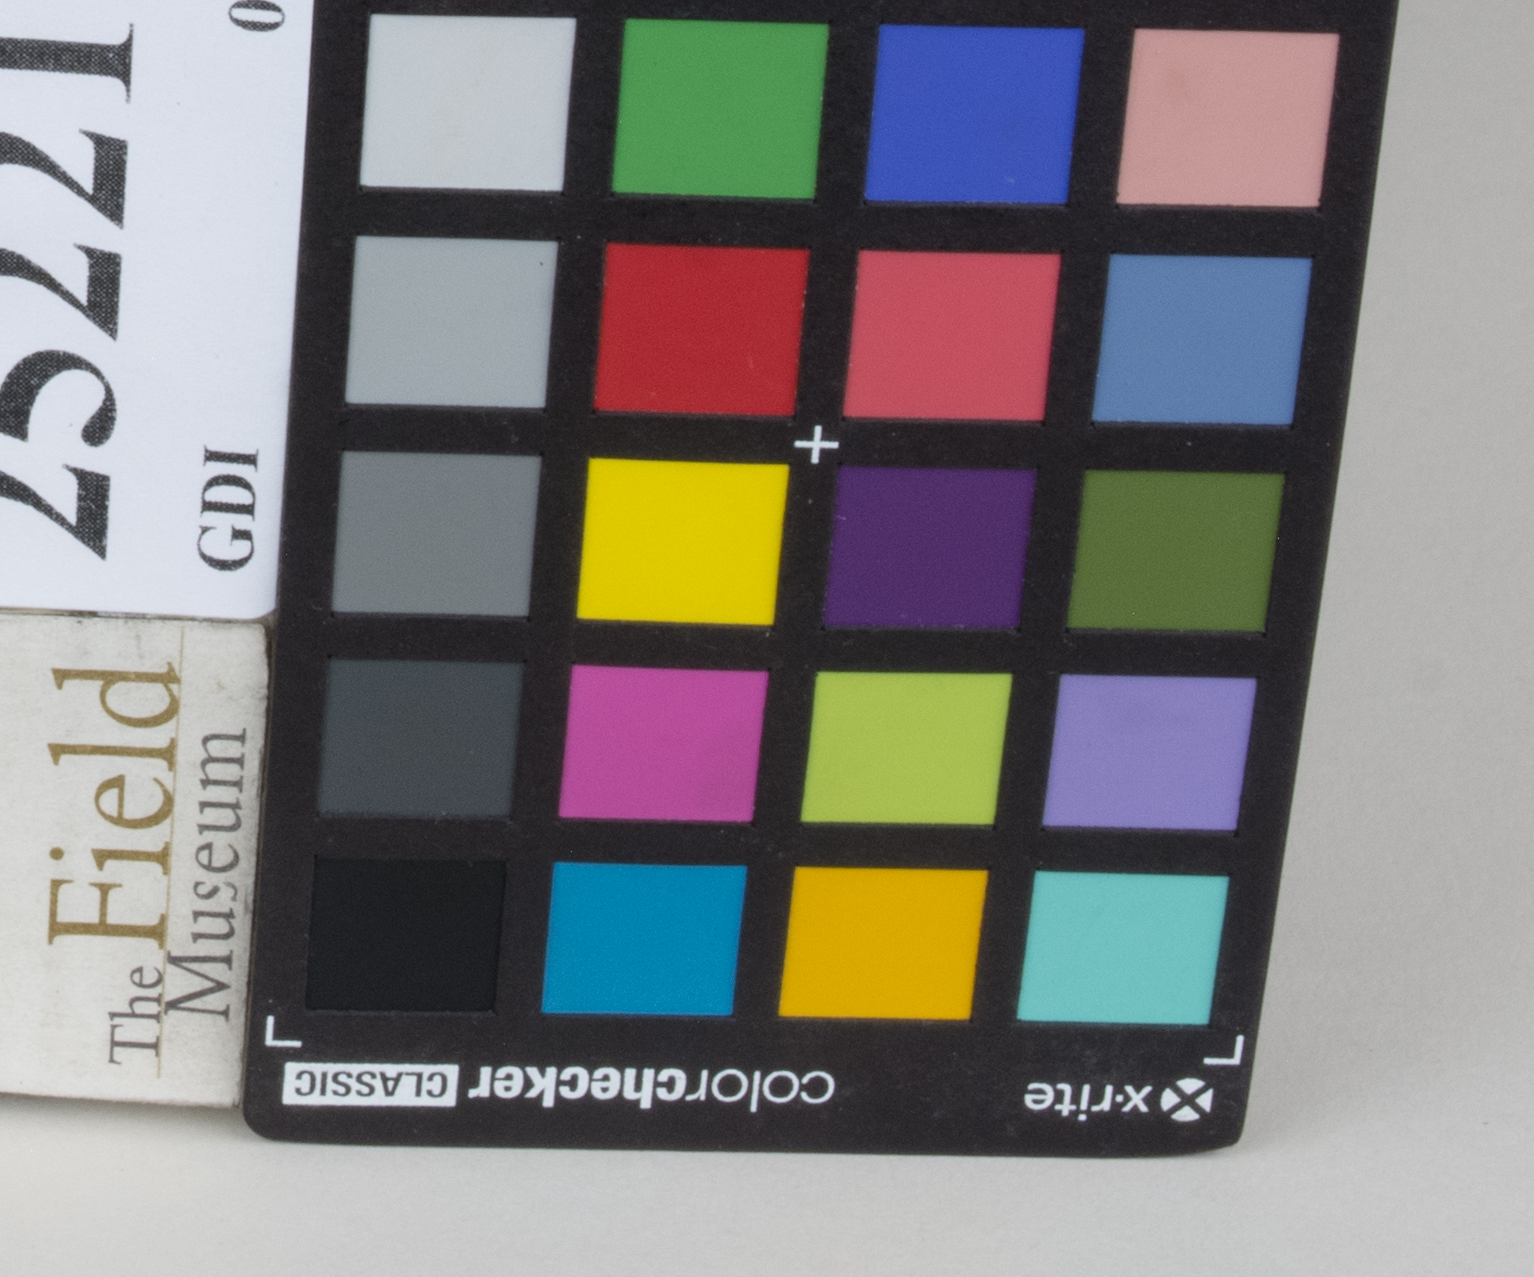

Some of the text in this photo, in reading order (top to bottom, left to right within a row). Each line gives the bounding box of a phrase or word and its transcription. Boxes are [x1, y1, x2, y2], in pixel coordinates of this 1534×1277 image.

[196, 445, 260, 572] GDI
[47, 662, 183, 1065] The Field
[164, 727, 247, 1021] Museum
[294, 1069, 449, 1098] CLASSIC
